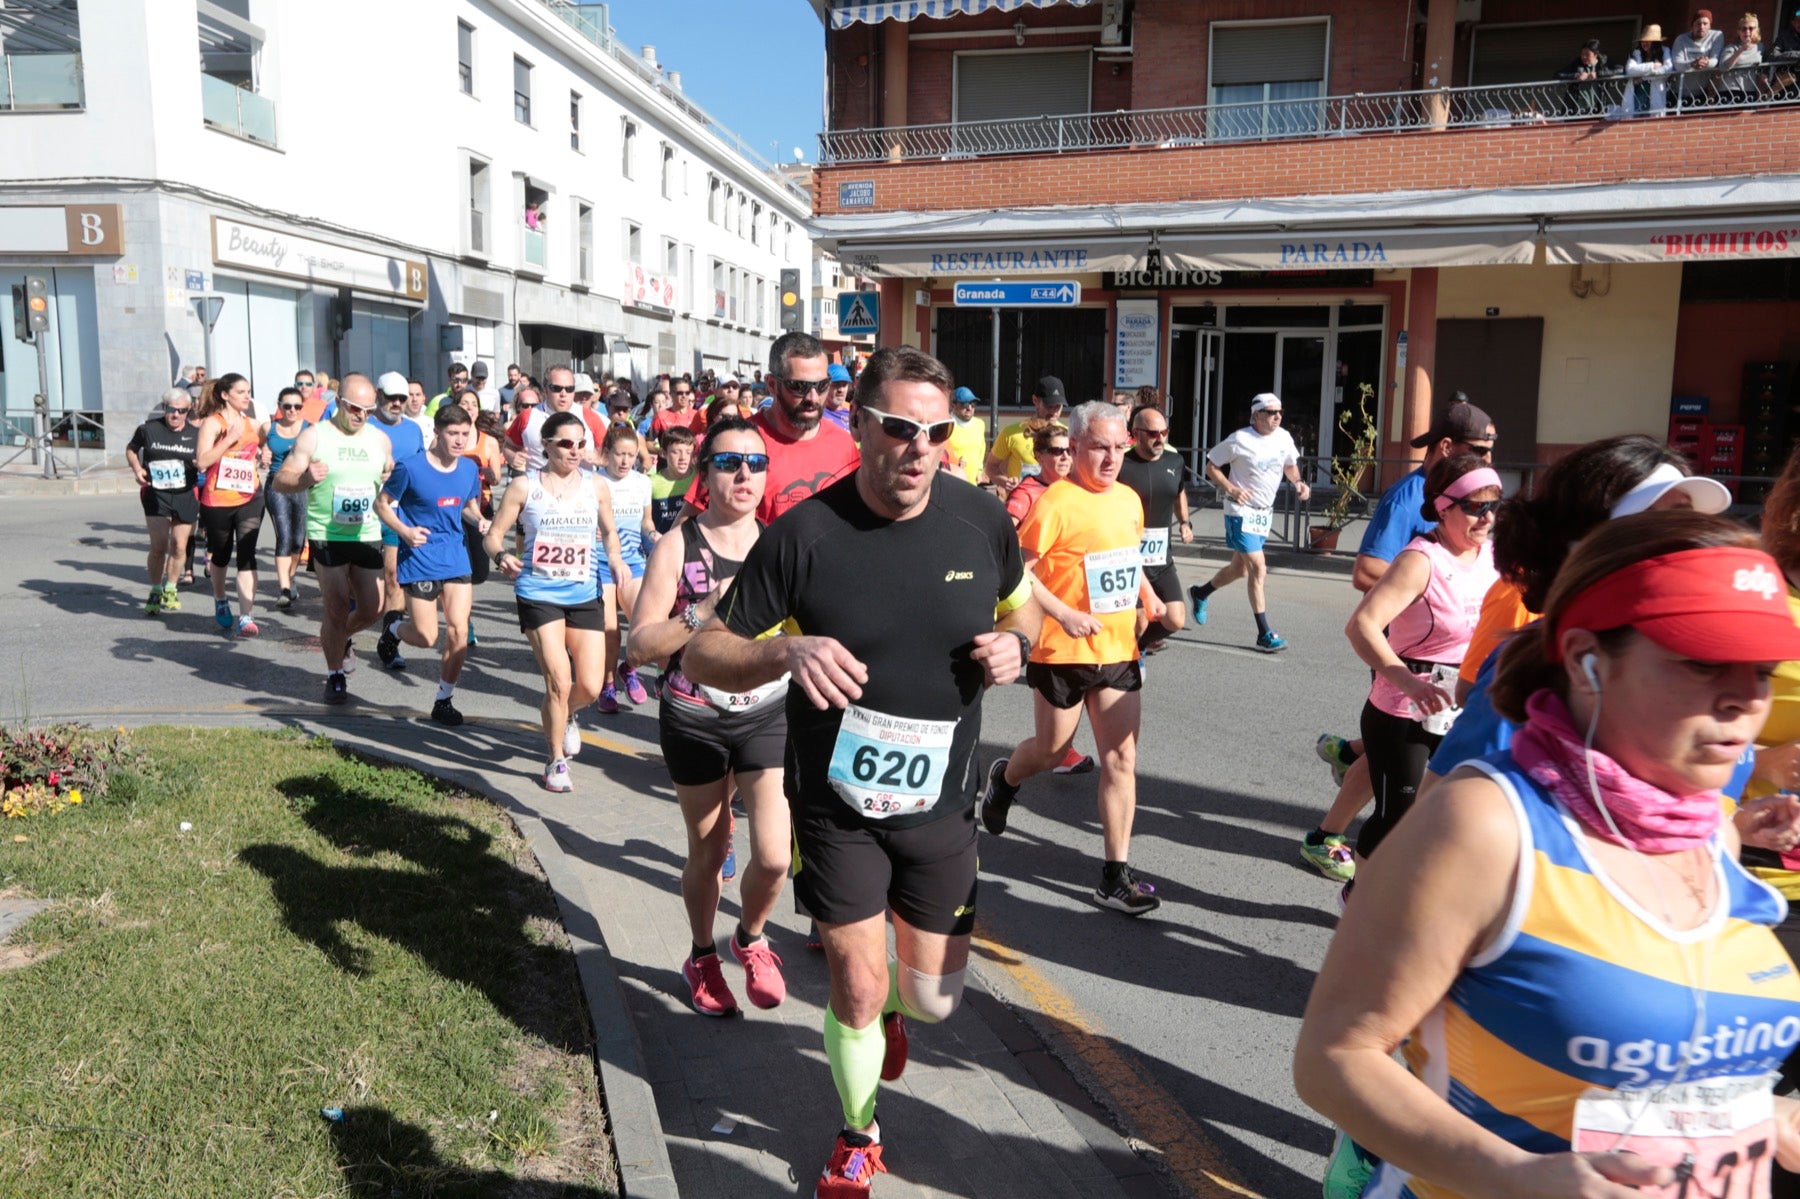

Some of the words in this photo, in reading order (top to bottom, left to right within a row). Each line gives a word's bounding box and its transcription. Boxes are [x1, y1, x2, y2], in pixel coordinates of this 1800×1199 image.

[80, 213, 104, 245] B
[229, 226, 287, 267] Beauty
[1280, 241, 1387, 264] PARADA
[931, 249, 1088, 272] RESTAURANTE
[412, 268, 422, 292] B
[1114, 269, 1222, 287] BICHITOS
[957, 288, 1006, 300] Granada
[338, 448, 368, 458] FILA
[157, 468, 180, 481] 914
[225, 467, 253, 482] 2309
[342, 497, 369, 512] 699
[540, 516, 593, 526] MARACENA
[537, 545, 586, 566] 2281
[1140, 540, 1164, 554] 707
[1100, 566, 1137, 593] 657
[872, 716, 893, 730] GRAN
[893, 720, 919, 733] PREMIO
[920, 724, 929, 734] DE
[853, 744, 931, 789] 620
